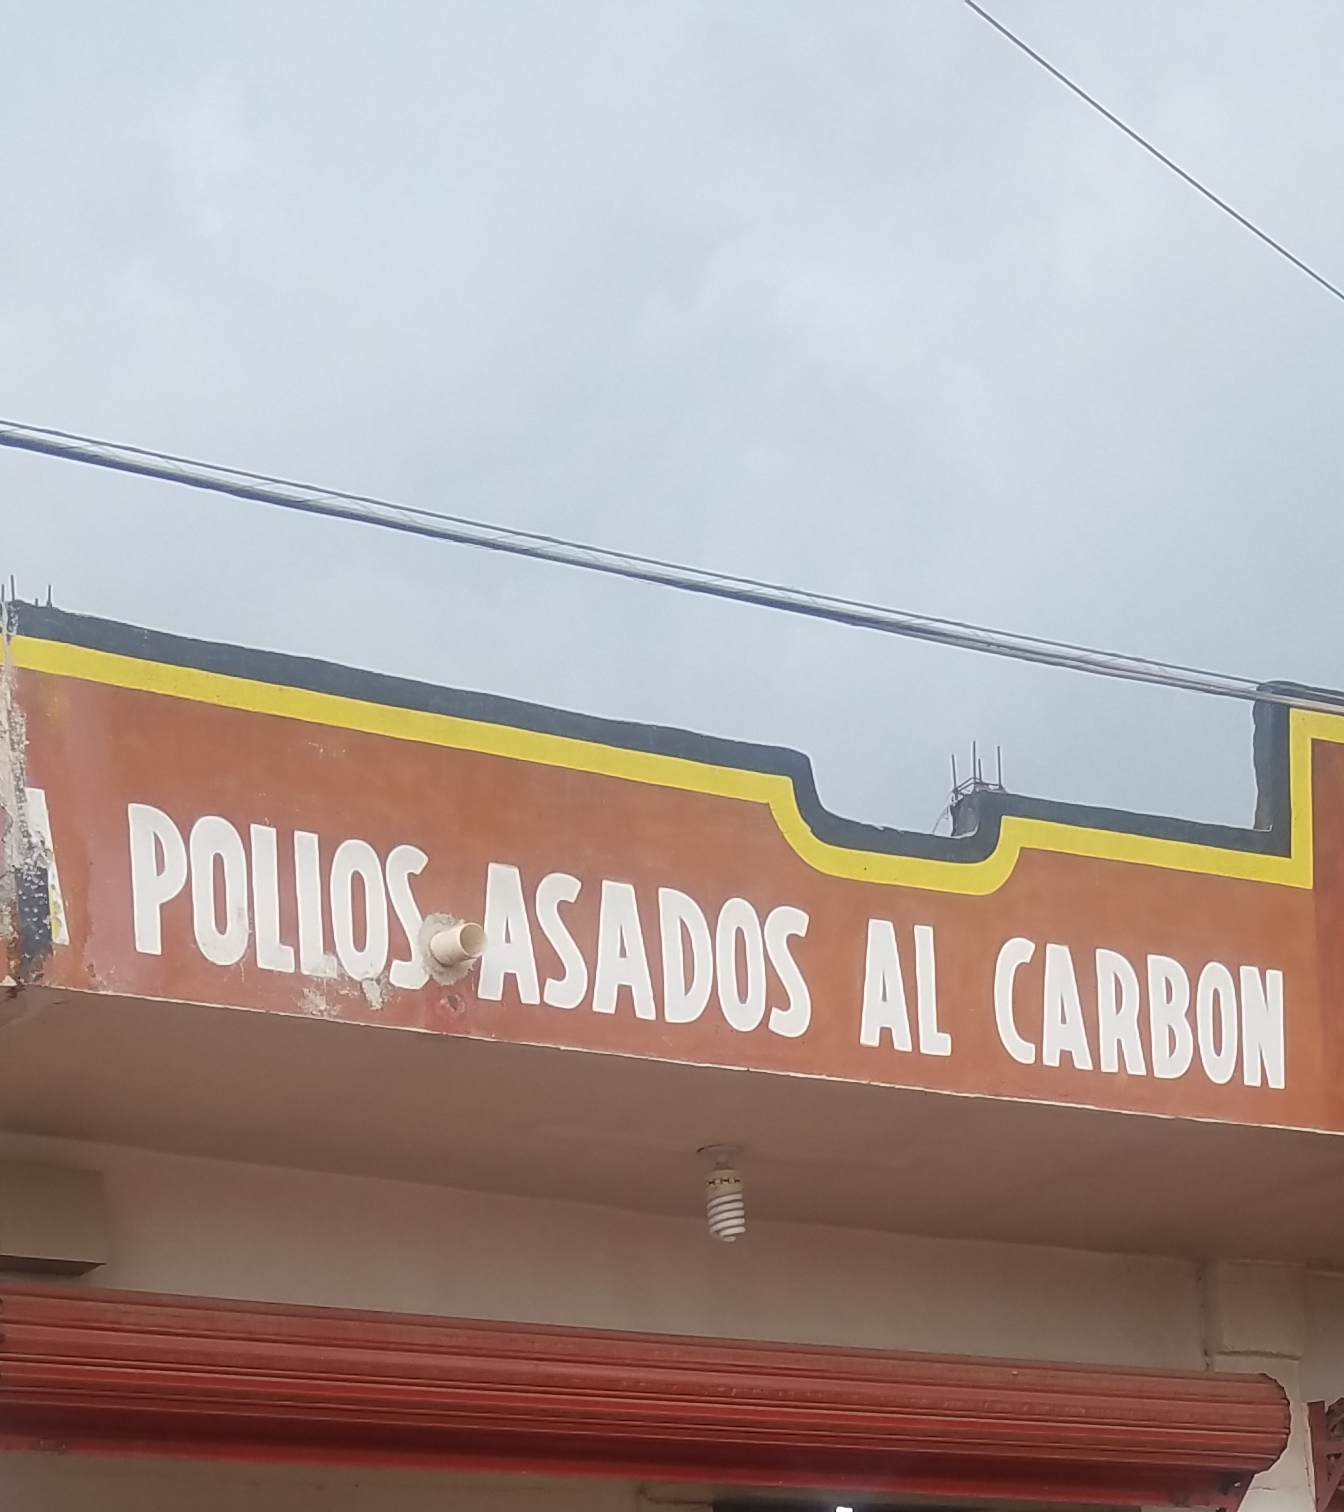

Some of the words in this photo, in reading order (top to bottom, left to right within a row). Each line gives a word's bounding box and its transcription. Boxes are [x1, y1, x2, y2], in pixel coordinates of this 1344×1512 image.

[127, 801, 433, 990] POLLOS
[477, 862, 812, 1038] ASADOS
[859, 917, 952, 1057] AL
[993, 936, 1286, 1090] CARBON
